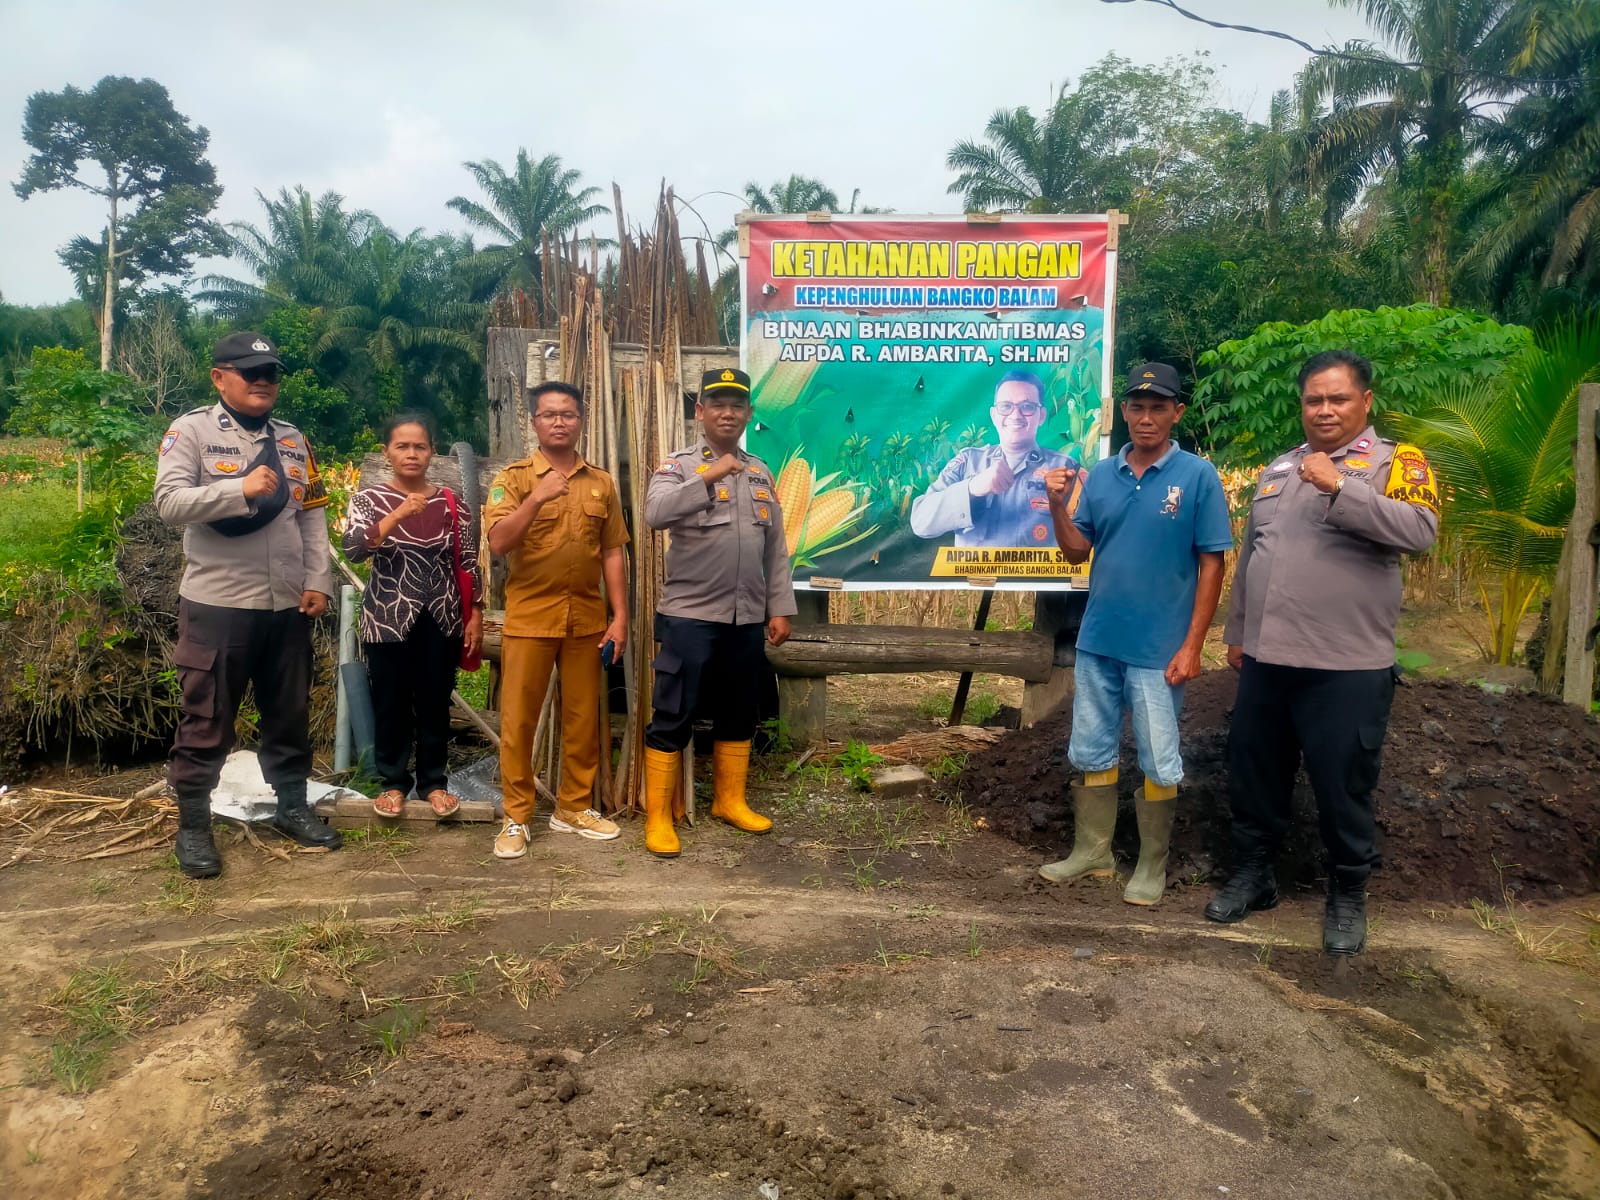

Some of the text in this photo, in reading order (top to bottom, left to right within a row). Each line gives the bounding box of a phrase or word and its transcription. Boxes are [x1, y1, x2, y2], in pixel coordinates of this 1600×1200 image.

[772, 241, 1081, 279] KETAHANAN PANGAN
[796, 286, 1056, 307] KEPENGHULUAN BANGKO BALAM
[763, 320, 1086, 340] BINAAN BHABINKAMTIBMAS
[780, 343, 1070, 366] AIPDA R. AMBARITA, SH.MH
[946, 550, 979, 563] AIPDA
[982, 550, 992, 563] R.
[994, 550, 1053, 564] AMBARITA,
[954, 565, 1082, 575] BHABINKAMTIBMAS BANGKO BALAM
